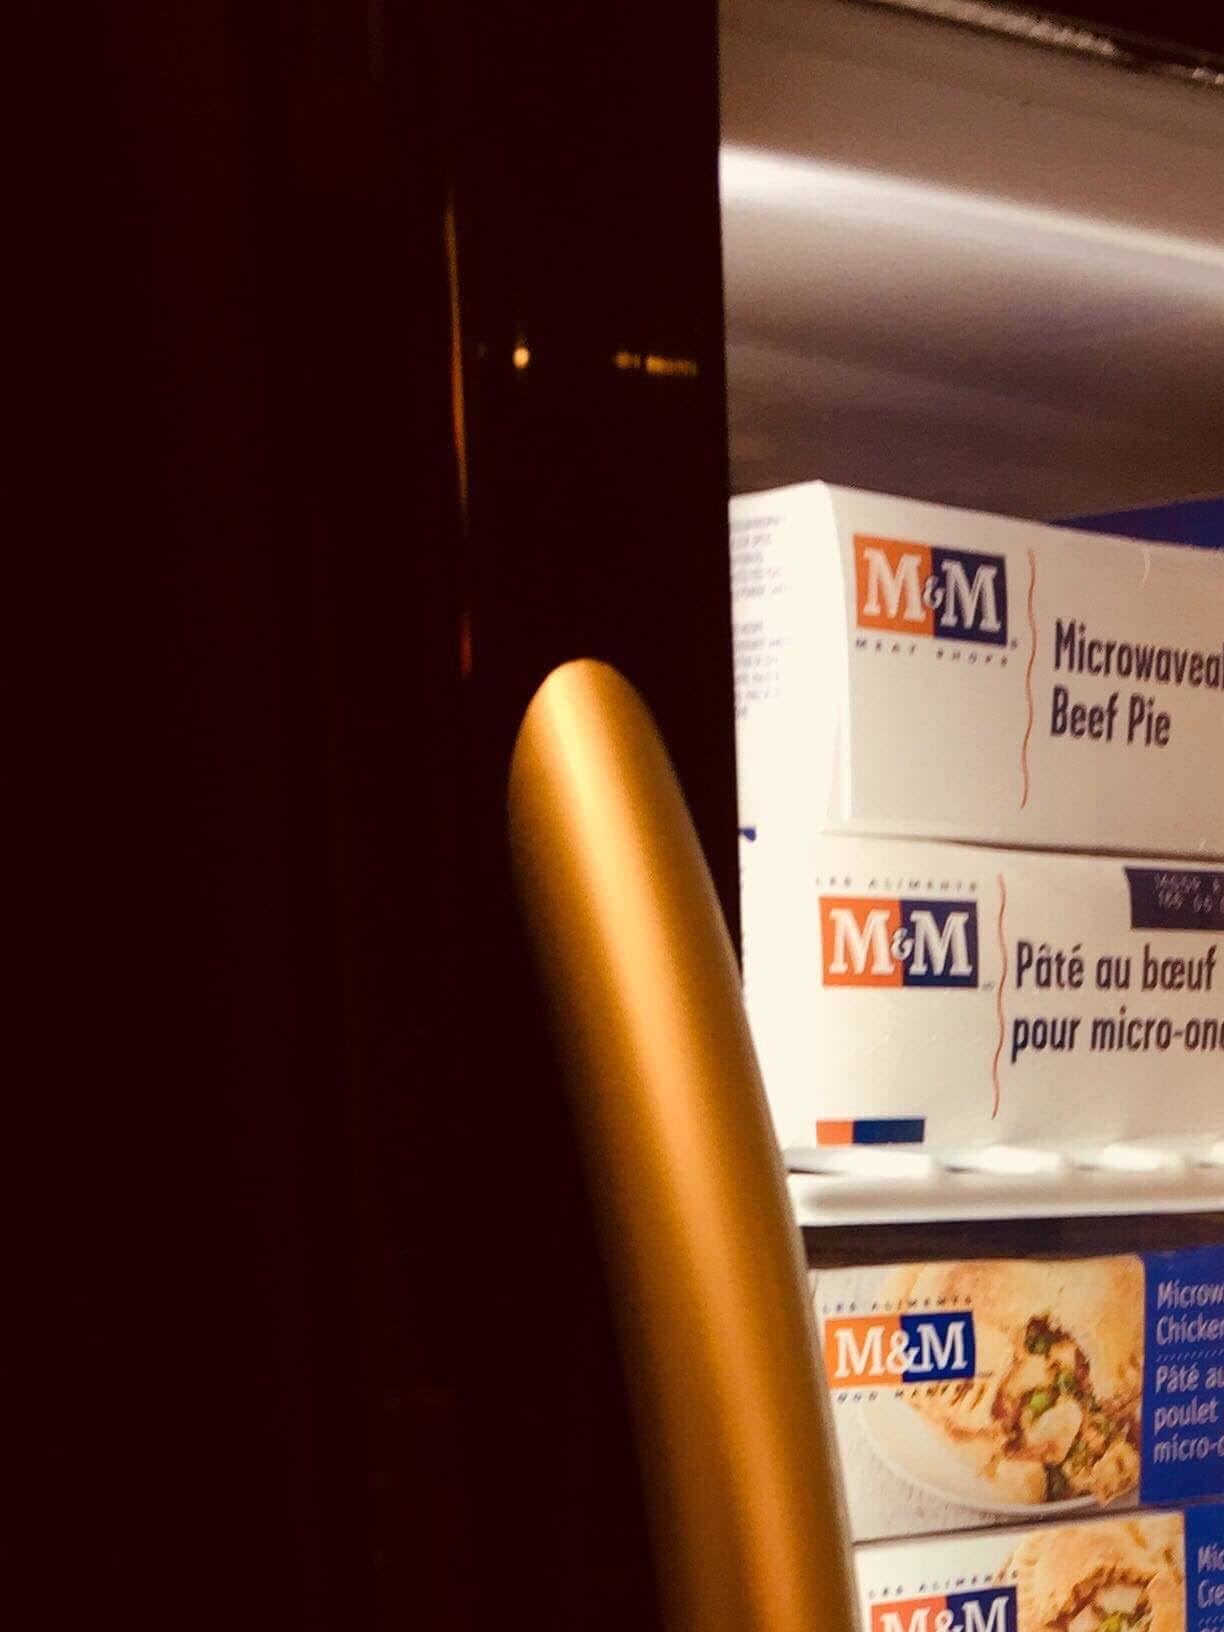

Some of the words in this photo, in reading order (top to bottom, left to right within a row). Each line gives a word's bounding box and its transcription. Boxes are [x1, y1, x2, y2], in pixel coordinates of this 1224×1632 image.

[862, 547, 1002, 633] M&M
[1050, 683, 1119, 743] Beef
[1127, 692, 1171, 749] Pie
[828, 908, 974, 977] M&M
[1015, 940, 1085, 992] Pâté
[1095, 953, 1131, 992] au
[1140, 943, 1218, 993] bœuf
[1011, 1015, 1082, 1066] pour
[834, 1320, 968, 1379] M&M
[1155, 1363, 1200, 1394] Pâté
[1153, 1395, 1220, 1436] poulet
